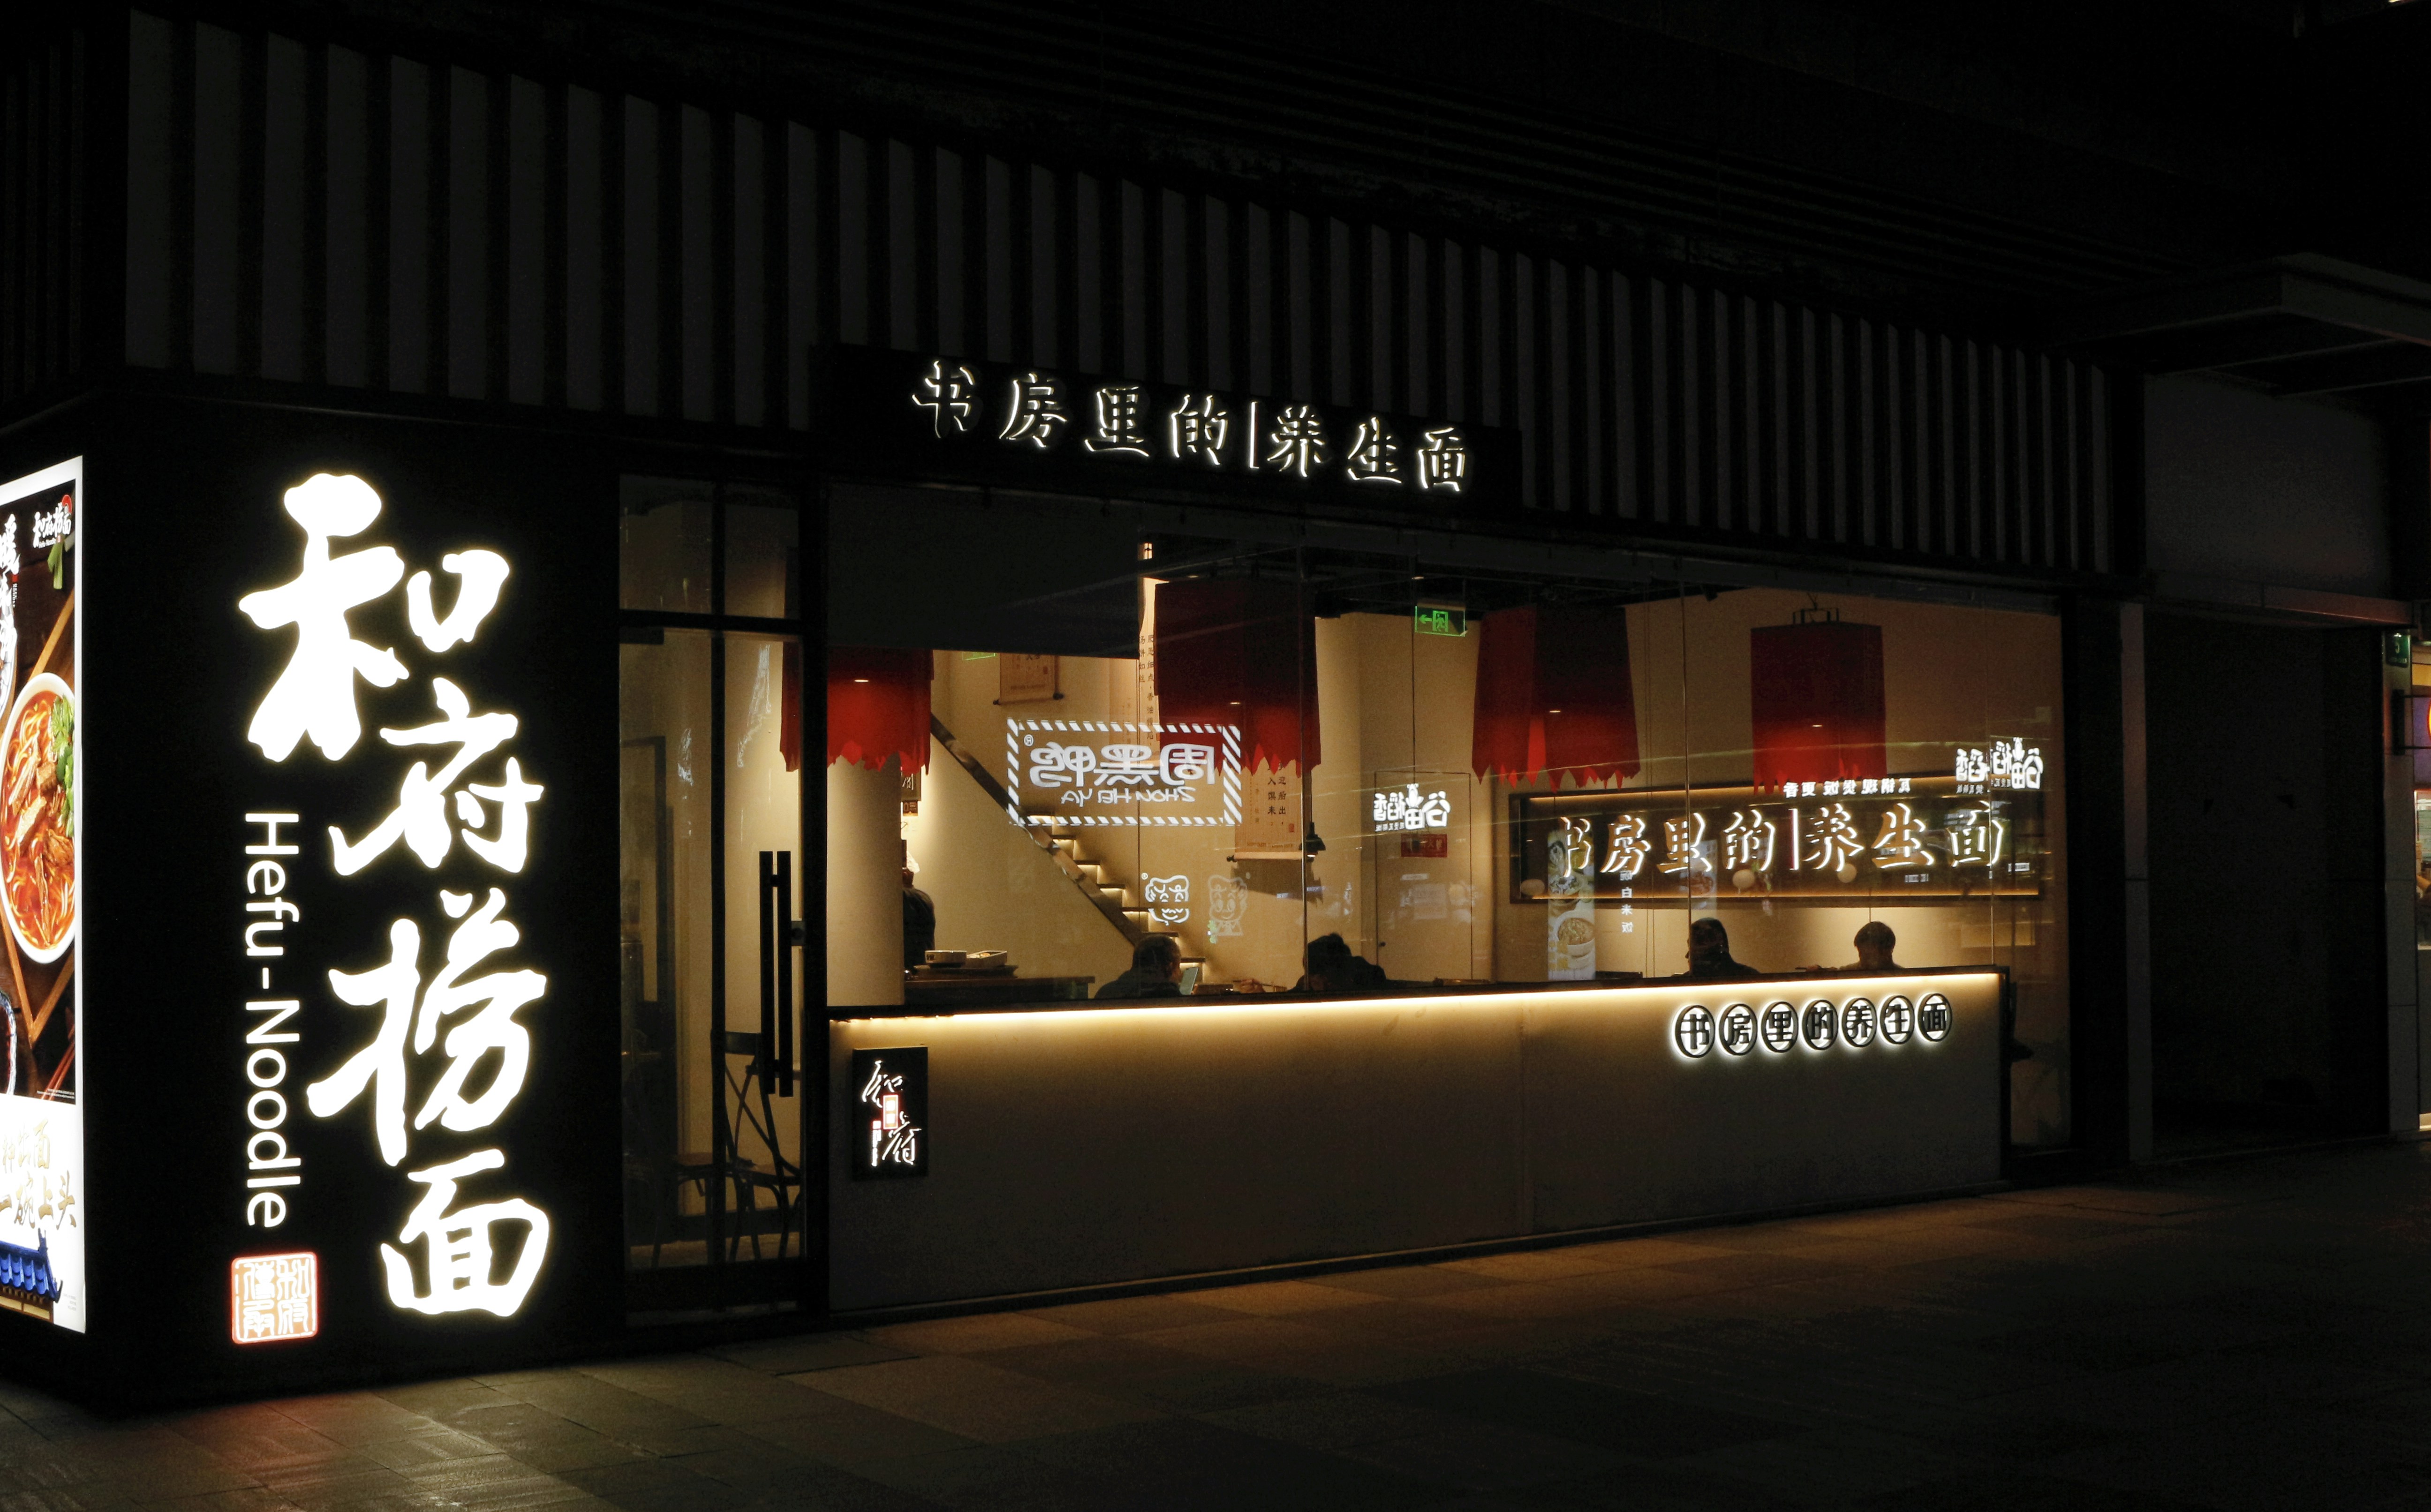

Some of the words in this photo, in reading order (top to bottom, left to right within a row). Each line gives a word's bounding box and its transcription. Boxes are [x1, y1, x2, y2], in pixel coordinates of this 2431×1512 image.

[239, 472, 550, 1317] 和府捞面
[245, 811, 301, 1229] Hefu-Noodle
[1679, 1001, 1947, 1051] 书房里的养生面
